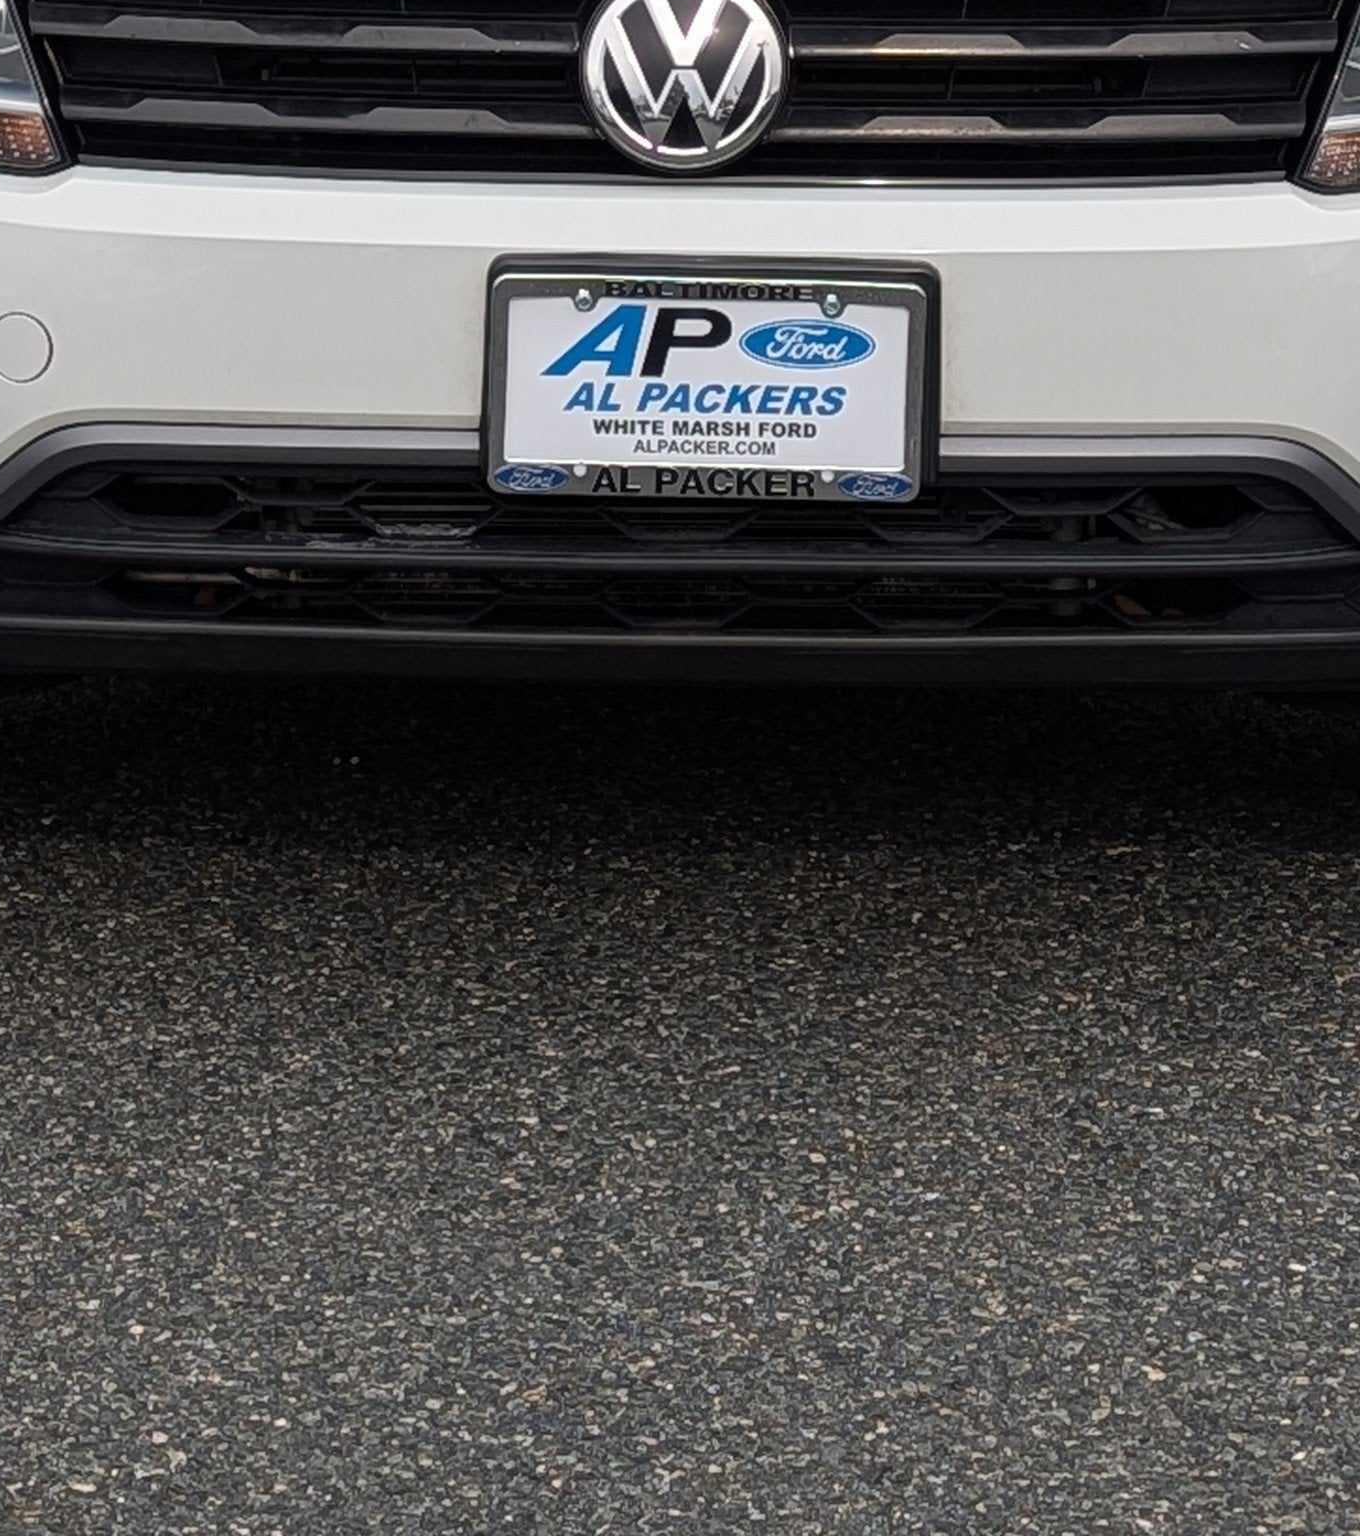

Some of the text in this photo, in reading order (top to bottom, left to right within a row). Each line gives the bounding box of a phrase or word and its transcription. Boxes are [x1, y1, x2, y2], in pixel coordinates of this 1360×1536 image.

[604, 281, 814, 301] BALTIMORE
[540, 303, 849, 378] AP Ford
[563, 381, 847, 416] AL PACKERS
[592, 418, 817, 438] WHITE MARSH FORD
[633, 438, 776, 456] ALPACKER.COM
[508, 466, 899, 498] Ford AL PACKER Ford
